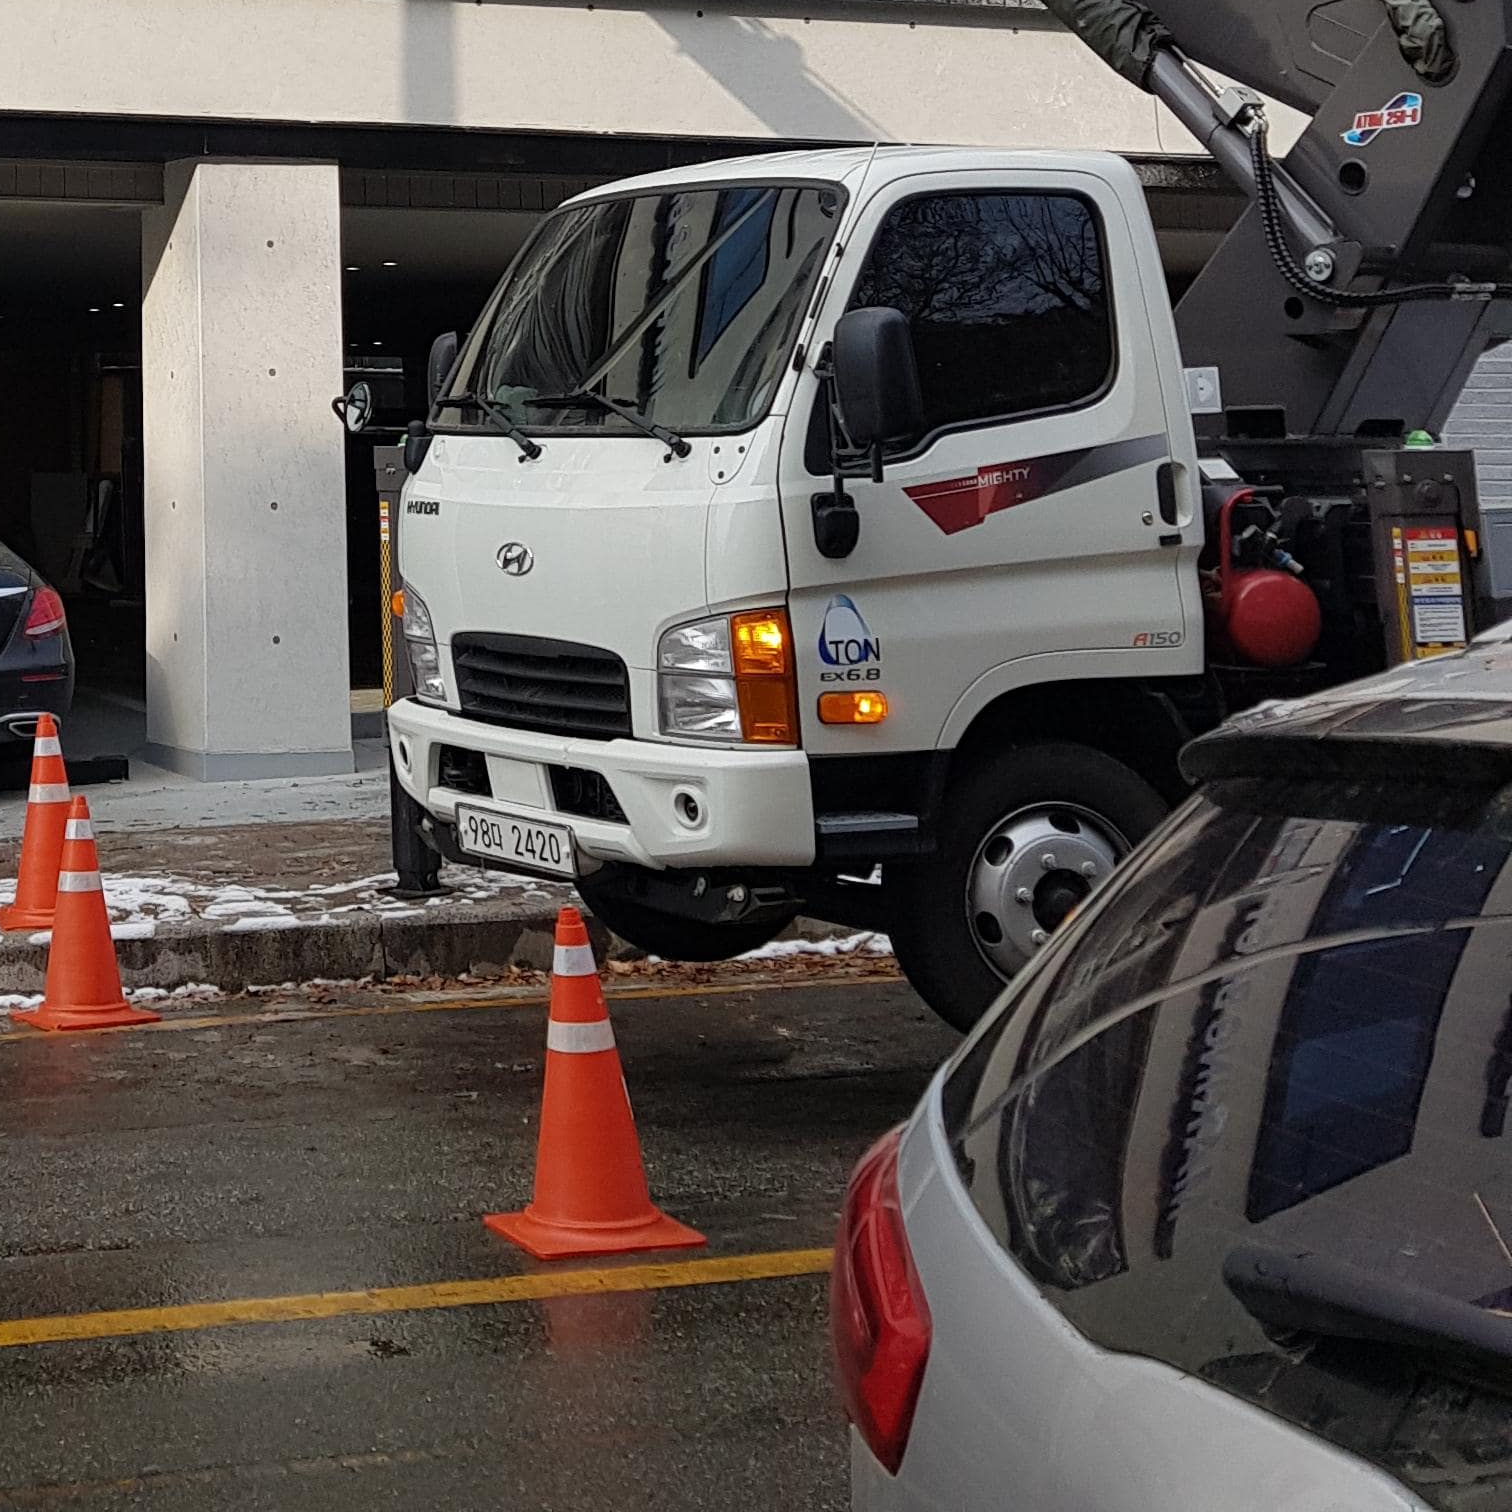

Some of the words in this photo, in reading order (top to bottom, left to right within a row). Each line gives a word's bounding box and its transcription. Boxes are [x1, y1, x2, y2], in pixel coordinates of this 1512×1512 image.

[977, 467, 1031, 488] MIGHTY
[819, 668, 881, 683] EX6.8
[511, 824, 562, 865] 2420
